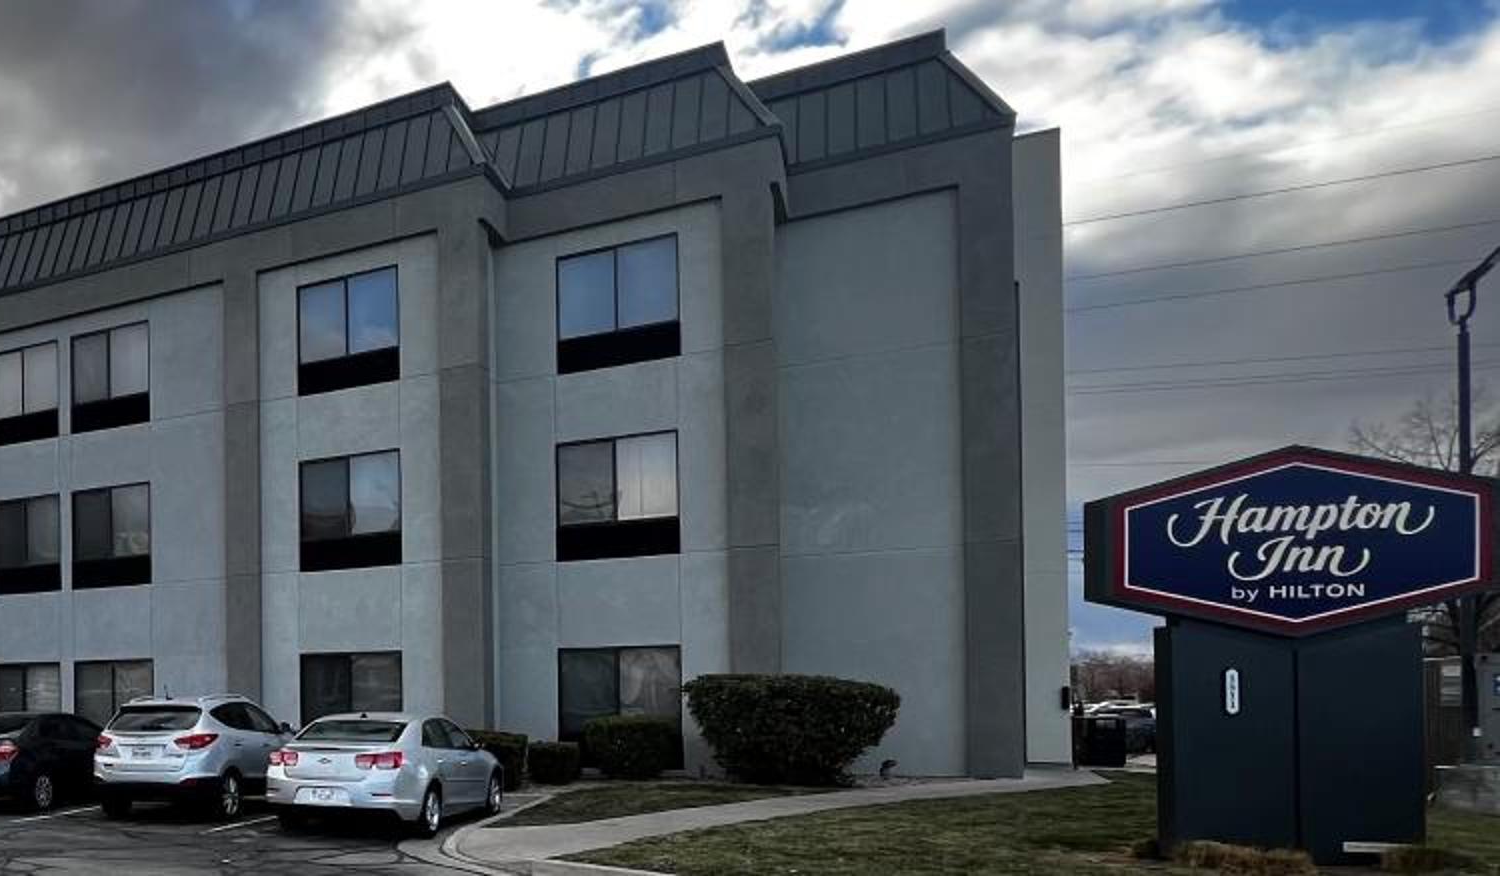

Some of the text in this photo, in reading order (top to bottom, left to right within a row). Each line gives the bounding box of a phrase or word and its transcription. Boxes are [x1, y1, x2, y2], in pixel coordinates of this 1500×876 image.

[1167, 493, 1435, 547] Hampton
[1227, 535, 1371, 581] Inn
[1231, 583, 1365, 602] by HILTON
